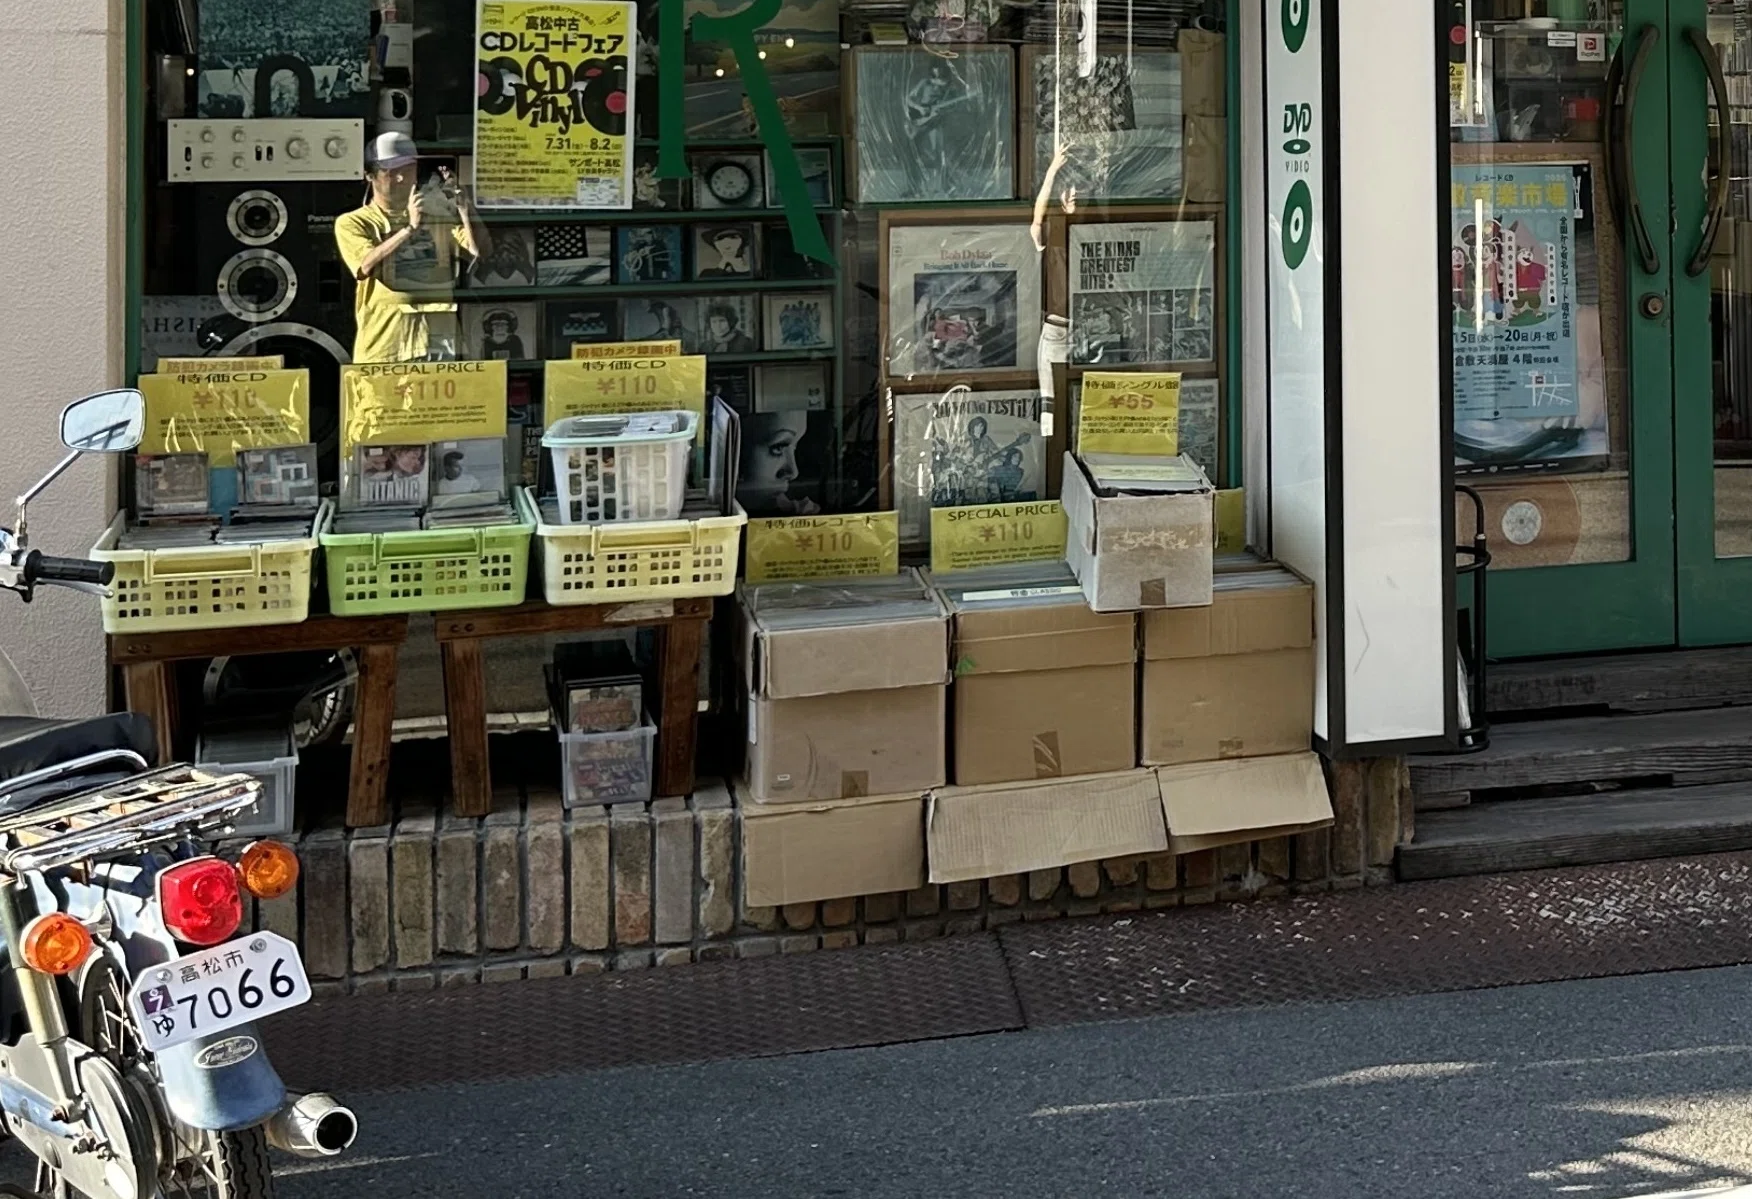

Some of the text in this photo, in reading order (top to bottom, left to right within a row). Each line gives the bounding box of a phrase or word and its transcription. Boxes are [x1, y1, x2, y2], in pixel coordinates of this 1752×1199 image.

[525, 15, 580, 31] 高松中古
[480, 31, 624, 53] CDレコードフェア
[526, 54, 572, 94] CD
[509, 83, 586, 134] Vinyl
[1283, 102, 1312, 137] DVD
[1285, 160, 1310, 173] VIDEO
[1080, 240, 1141, 258] THE KINKS
[1080, 257, 1136, 273] GREATEST
[360, 362, 485, 377] SPECIAL PRICE
[582, 360, 666, 371] 特価CD
[177, 373, 267, 384] 特価CD
[597, 375, 657, 395] ¥110
[1108, 393, 1155, 410] ¥55
[366, 477, 421, 502] TITANIC
[764, 515, 880, 529] 特価レコード
[947, 503, 1060, 522] SPECIAL PRICE
[795, 531, 853, 552] ¥110
[979, 521, 1033, 542] ¥110
[178, 950, 245, 985] 高松市
[177, 957, 296, 1029] 7066
[152, 1013, 175, 1038] ゆ
